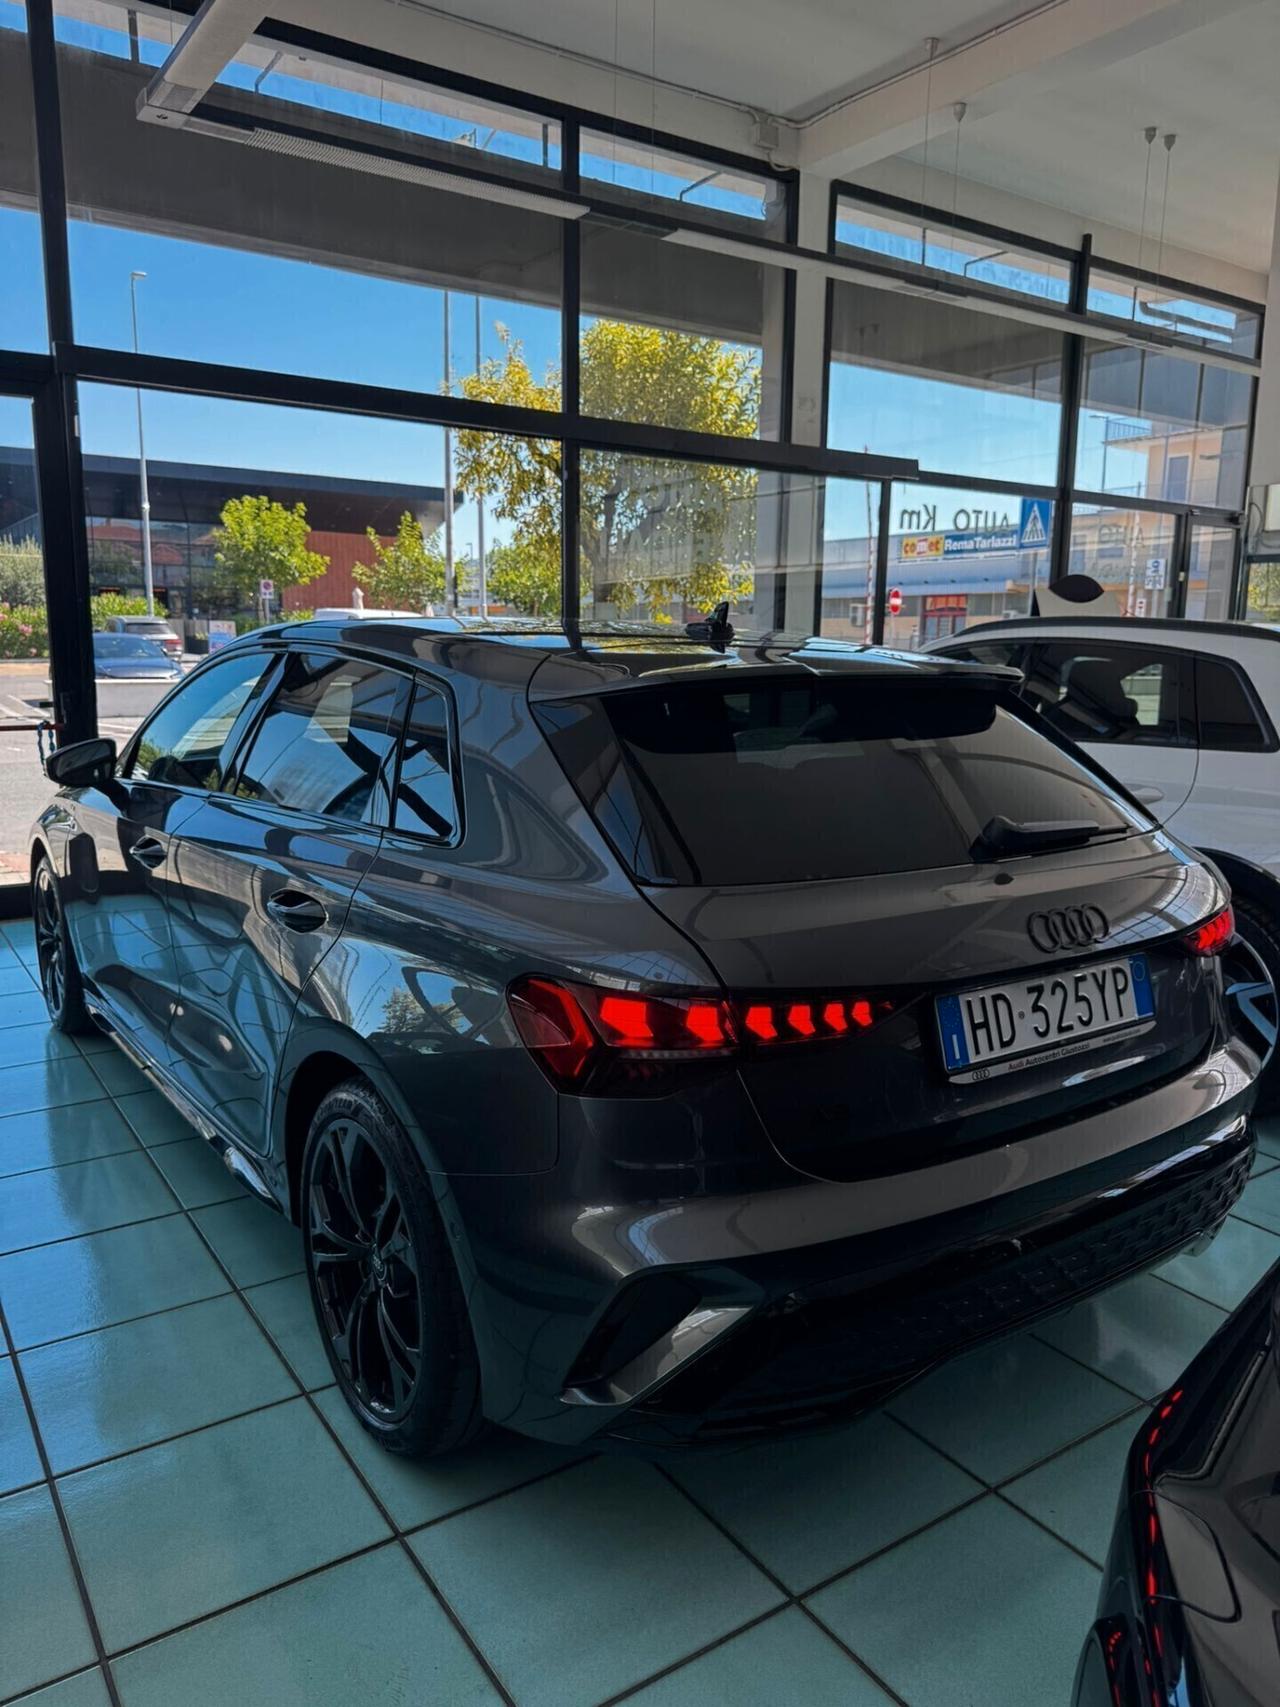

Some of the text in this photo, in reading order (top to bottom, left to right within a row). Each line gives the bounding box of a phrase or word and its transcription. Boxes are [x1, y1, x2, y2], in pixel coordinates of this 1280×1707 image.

[903, 538, 941, 556] comet
[966, 966, 1129, 1055] HD 325YP
[1008, 1060, 1025, 1071] Audi
